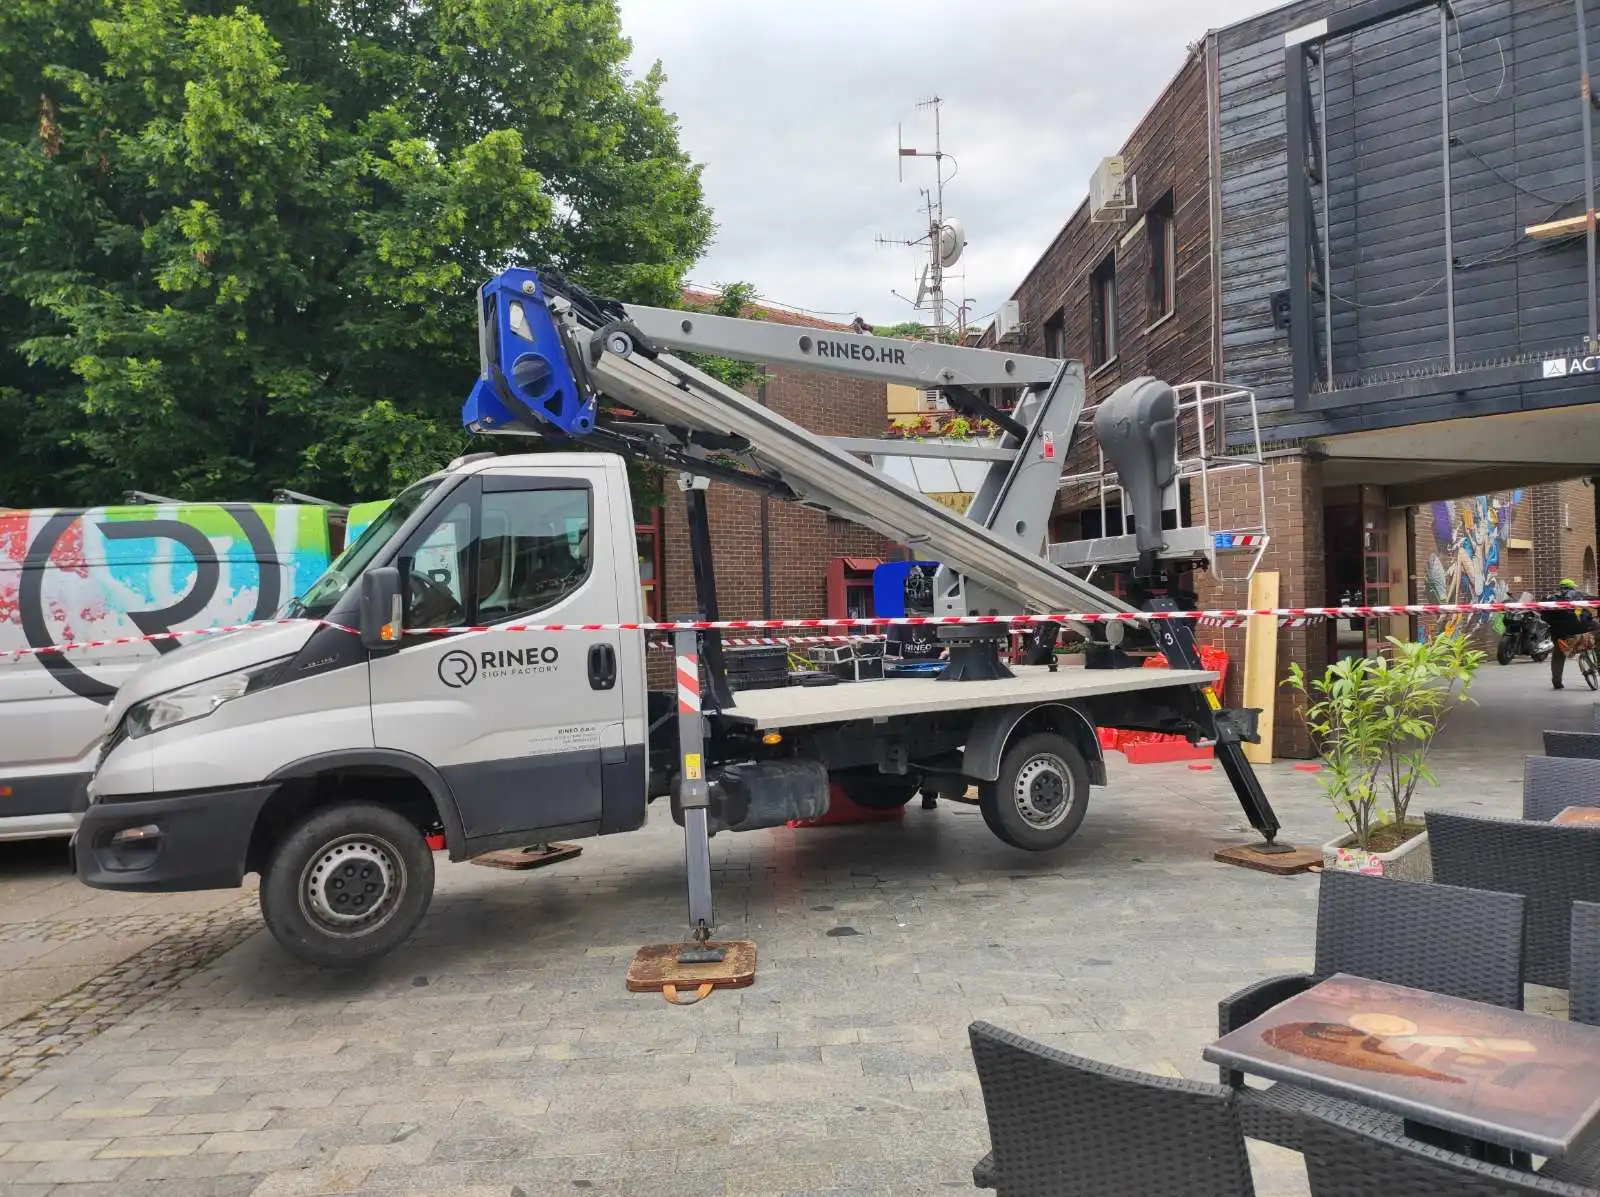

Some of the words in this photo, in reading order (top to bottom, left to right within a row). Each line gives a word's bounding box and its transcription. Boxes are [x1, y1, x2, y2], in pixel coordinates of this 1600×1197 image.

[817, 340, 905, 365] RINEO.HR
[1164, 632, 1174, 646] 3
[905, 643, 932, 651] RINEO
[481, 646, 559, 669] RINEO
[481, 670, 507, 679] SIGN
[511, 665, 558, 675] FACTORY
